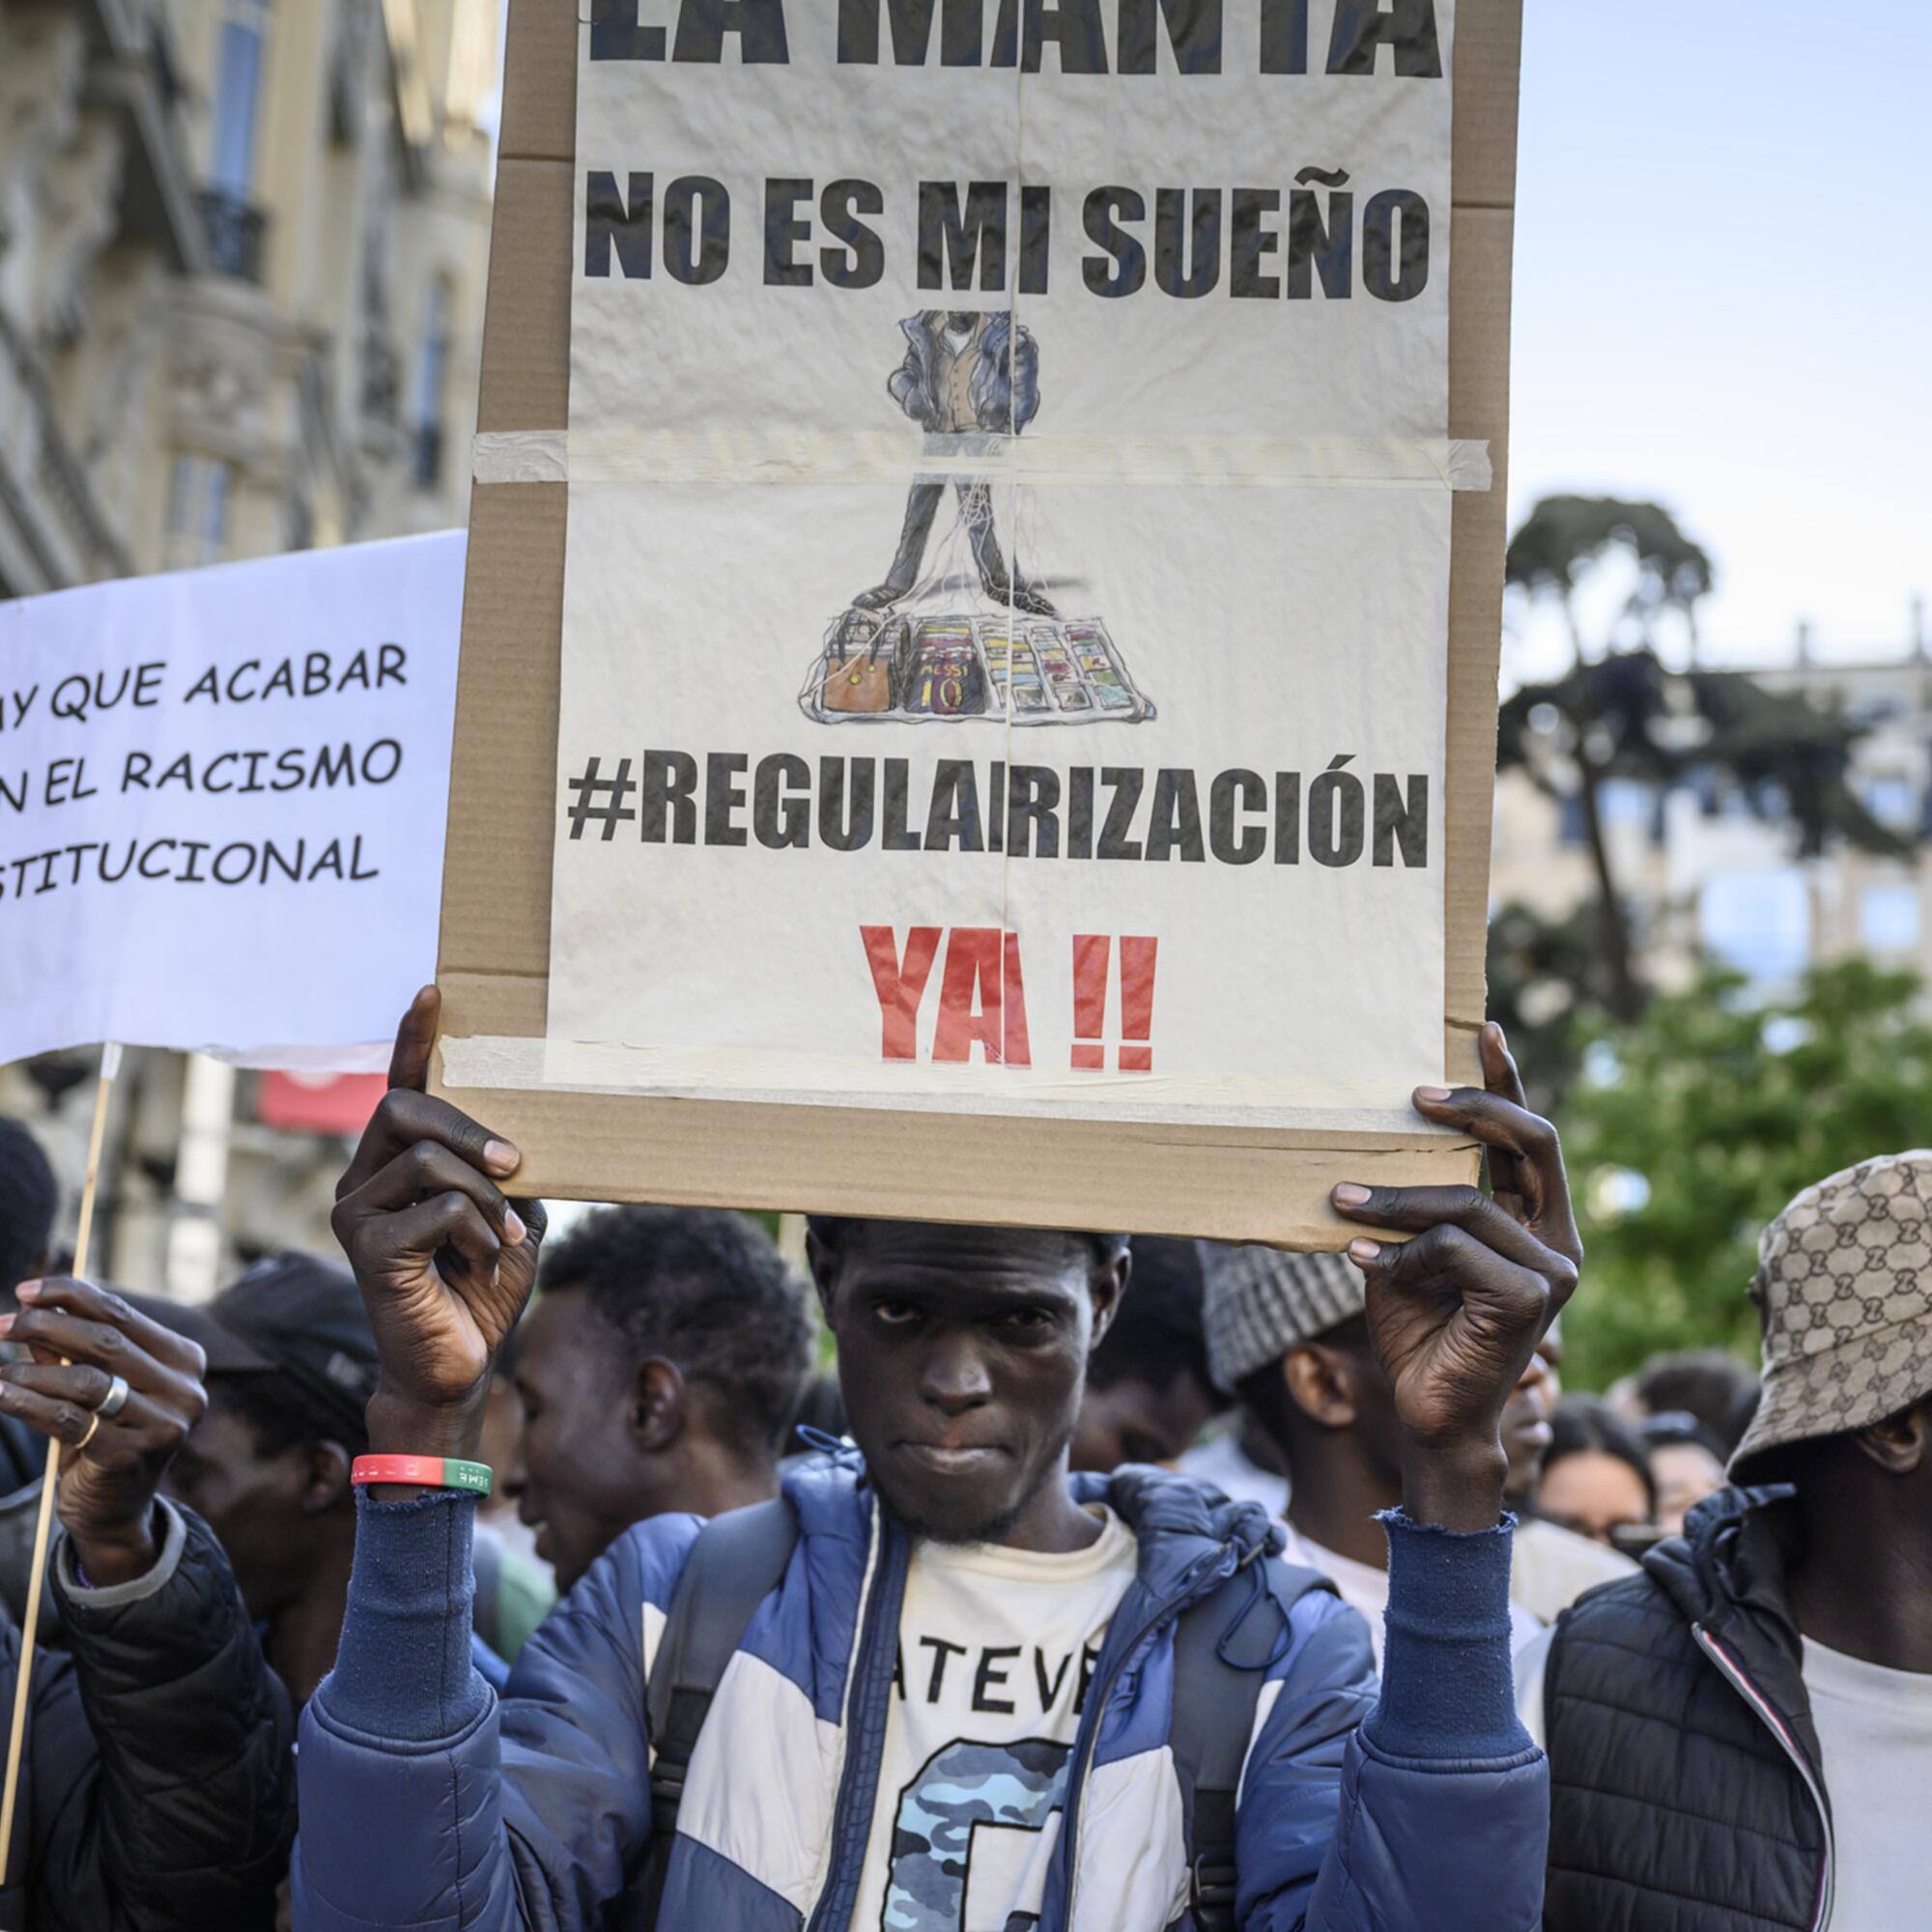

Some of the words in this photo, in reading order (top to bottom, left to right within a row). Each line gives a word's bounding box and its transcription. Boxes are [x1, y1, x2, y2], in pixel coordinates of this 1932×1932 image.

[584, 170, 730, 286] NO
[763, 177, 885, 289] ES
[917, 181, 1051, 296] MI
[1081, 166, 1430, 302] SUEÑO
[0, 682, 39, 732] Y
[50, 662, 167, 723] QUE
[184, 643, 408, 704] ACABAR
[44, 757, 98, 807] EL
[121, 738, 403, 793] RACISMO
[0, 835, 380, 899] TITUCIONAL
[860, 925, 1032, 1069] YA
[1070, 934, 1158, 1072] !!
